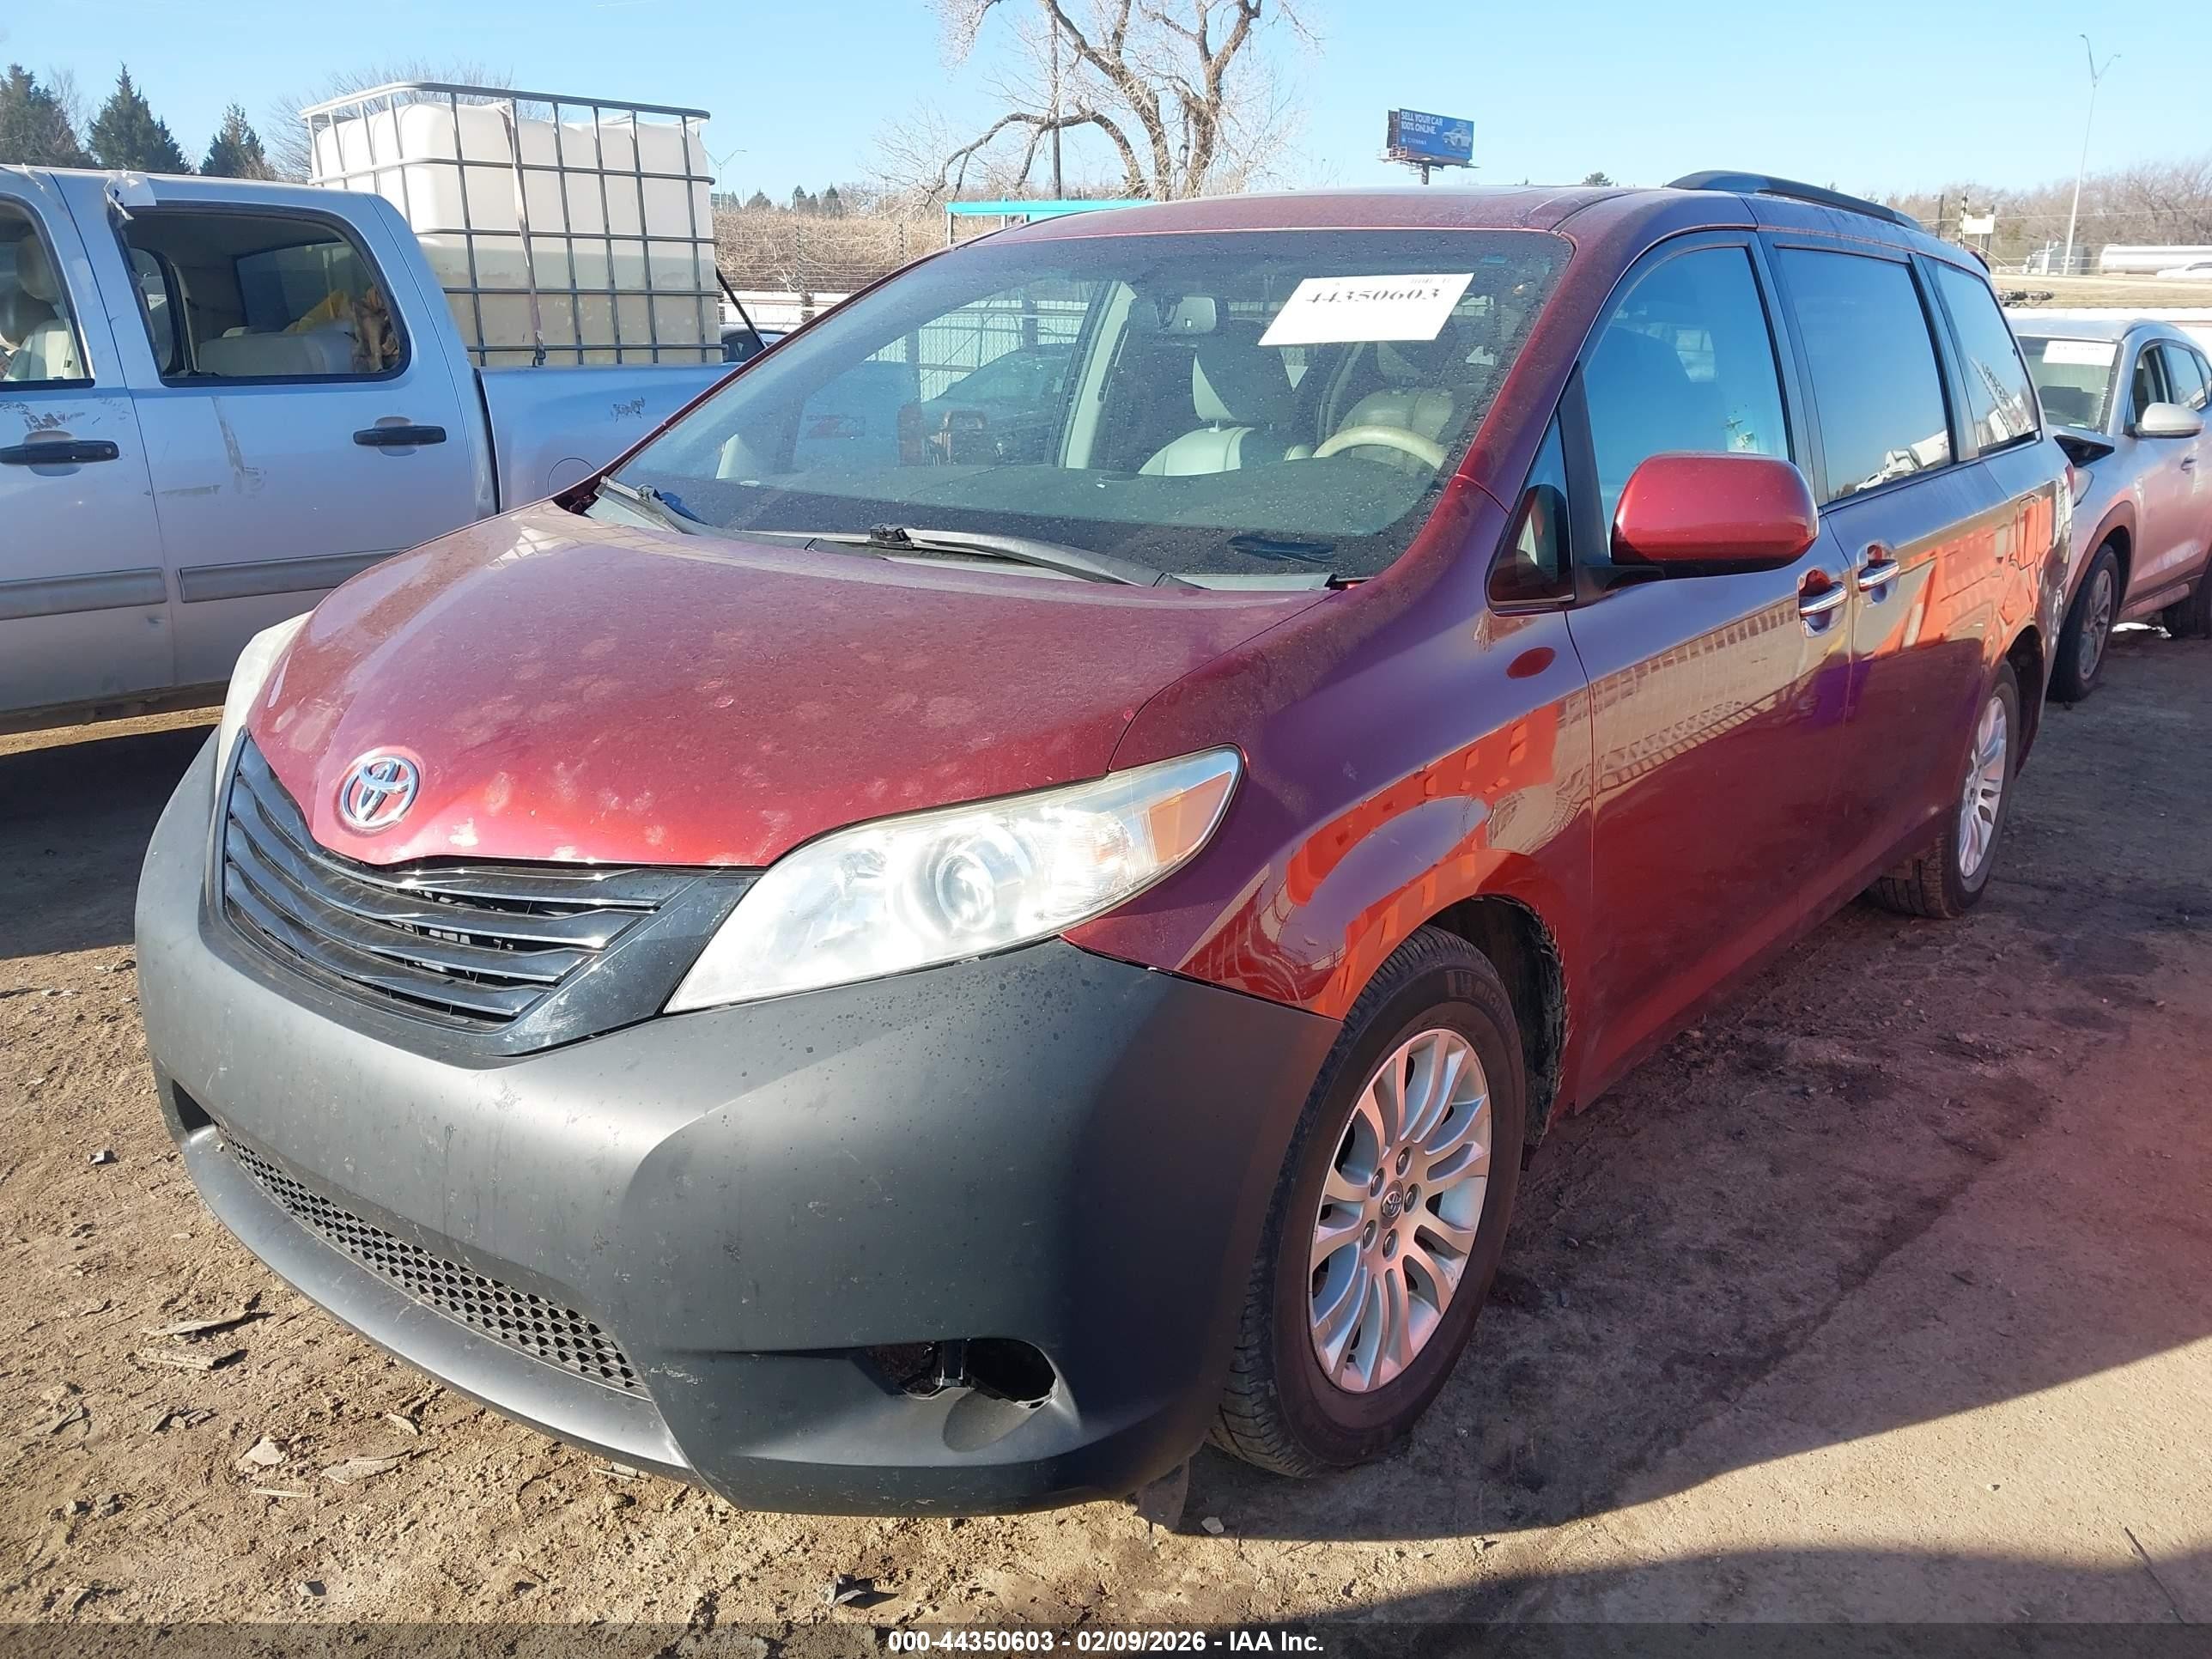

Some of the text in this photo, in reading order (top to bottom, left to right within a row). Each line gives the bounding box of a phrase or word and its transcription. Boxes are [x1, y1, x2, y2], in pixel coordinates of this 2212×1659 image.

[1401, 112, 1443, 126] SELL YOUR CAR
[1305, 288, 1441, 303] 44350603
